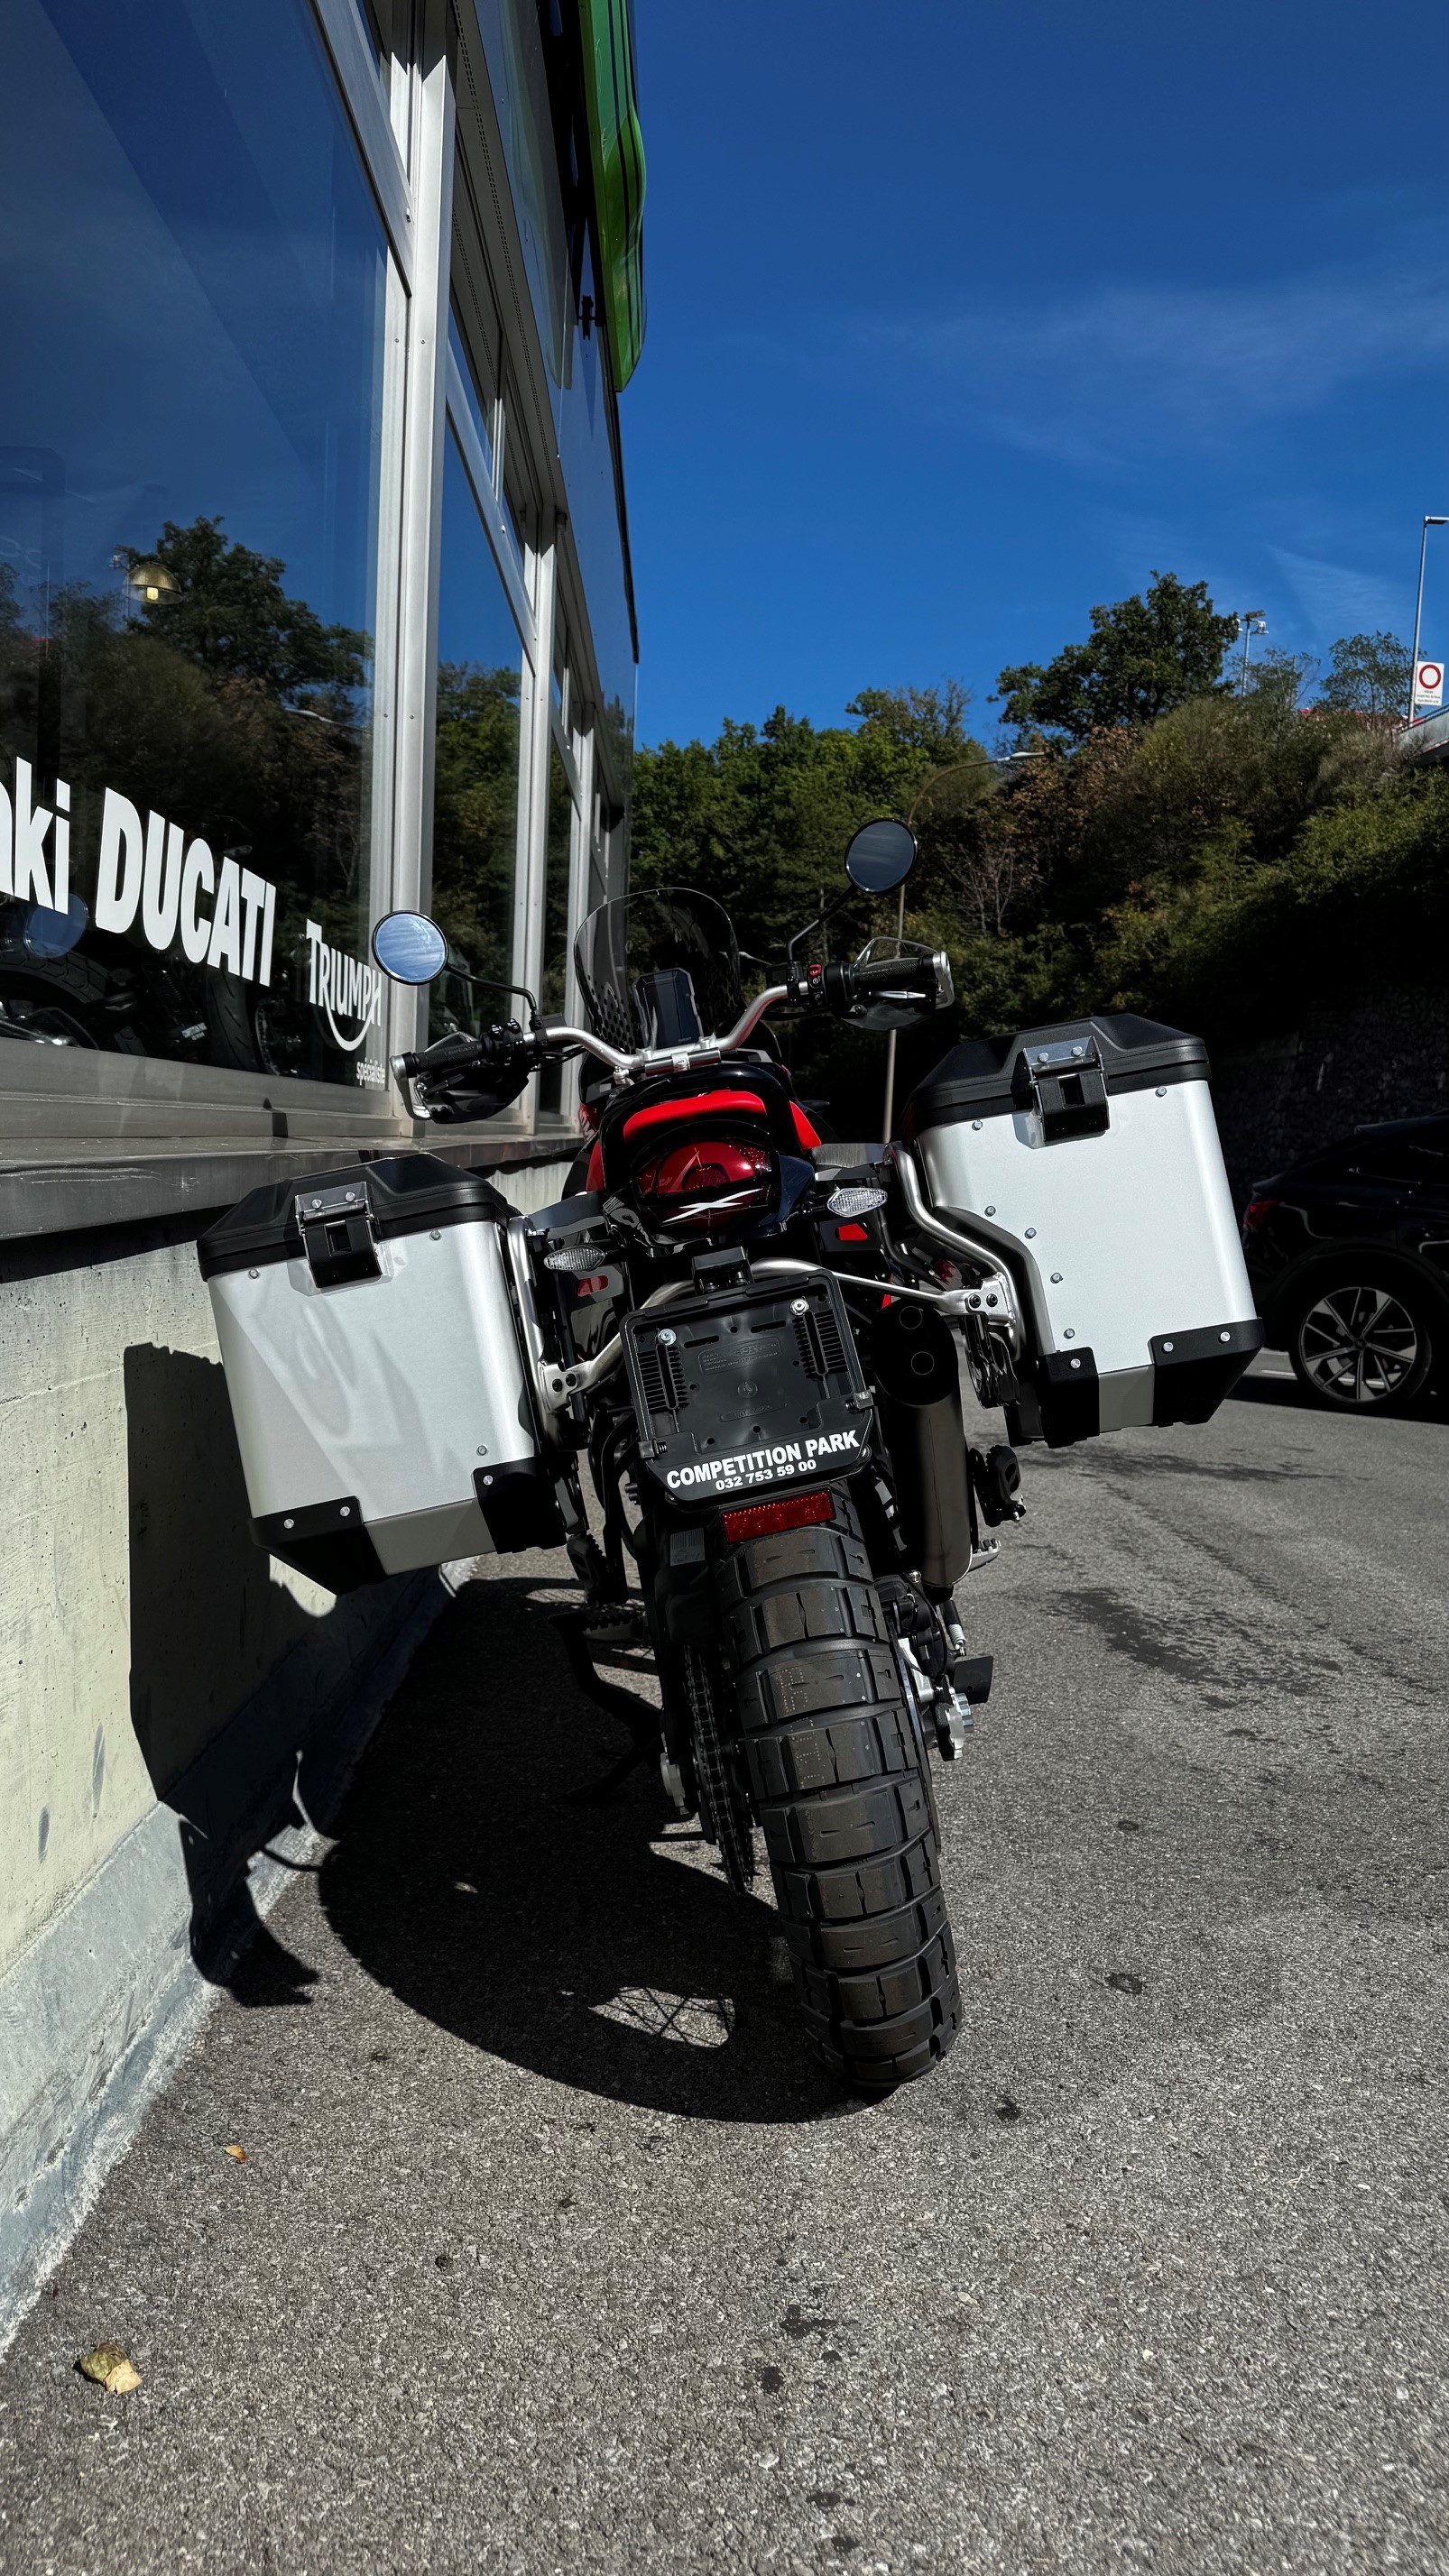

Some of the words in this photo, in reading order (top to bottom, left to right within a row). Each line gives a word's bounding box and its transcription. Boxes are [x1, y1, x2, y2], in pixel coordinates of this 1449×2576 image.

[95, 787, 276, 987] DUCATI
[306, 918, 383, 1051] TRIUMPH
[356, 1056, 385, 1086] spécialiste
[666, 1442, 802, 1489] COMPETITION
[804, 1430, 861, 1458] PARK
[715, 1476, 743, 1491] 032
[745, 1469, 774, 1485] 753
[776, 1464, 795, 1477] 59
[798, 1458, 817, 1472] 00
